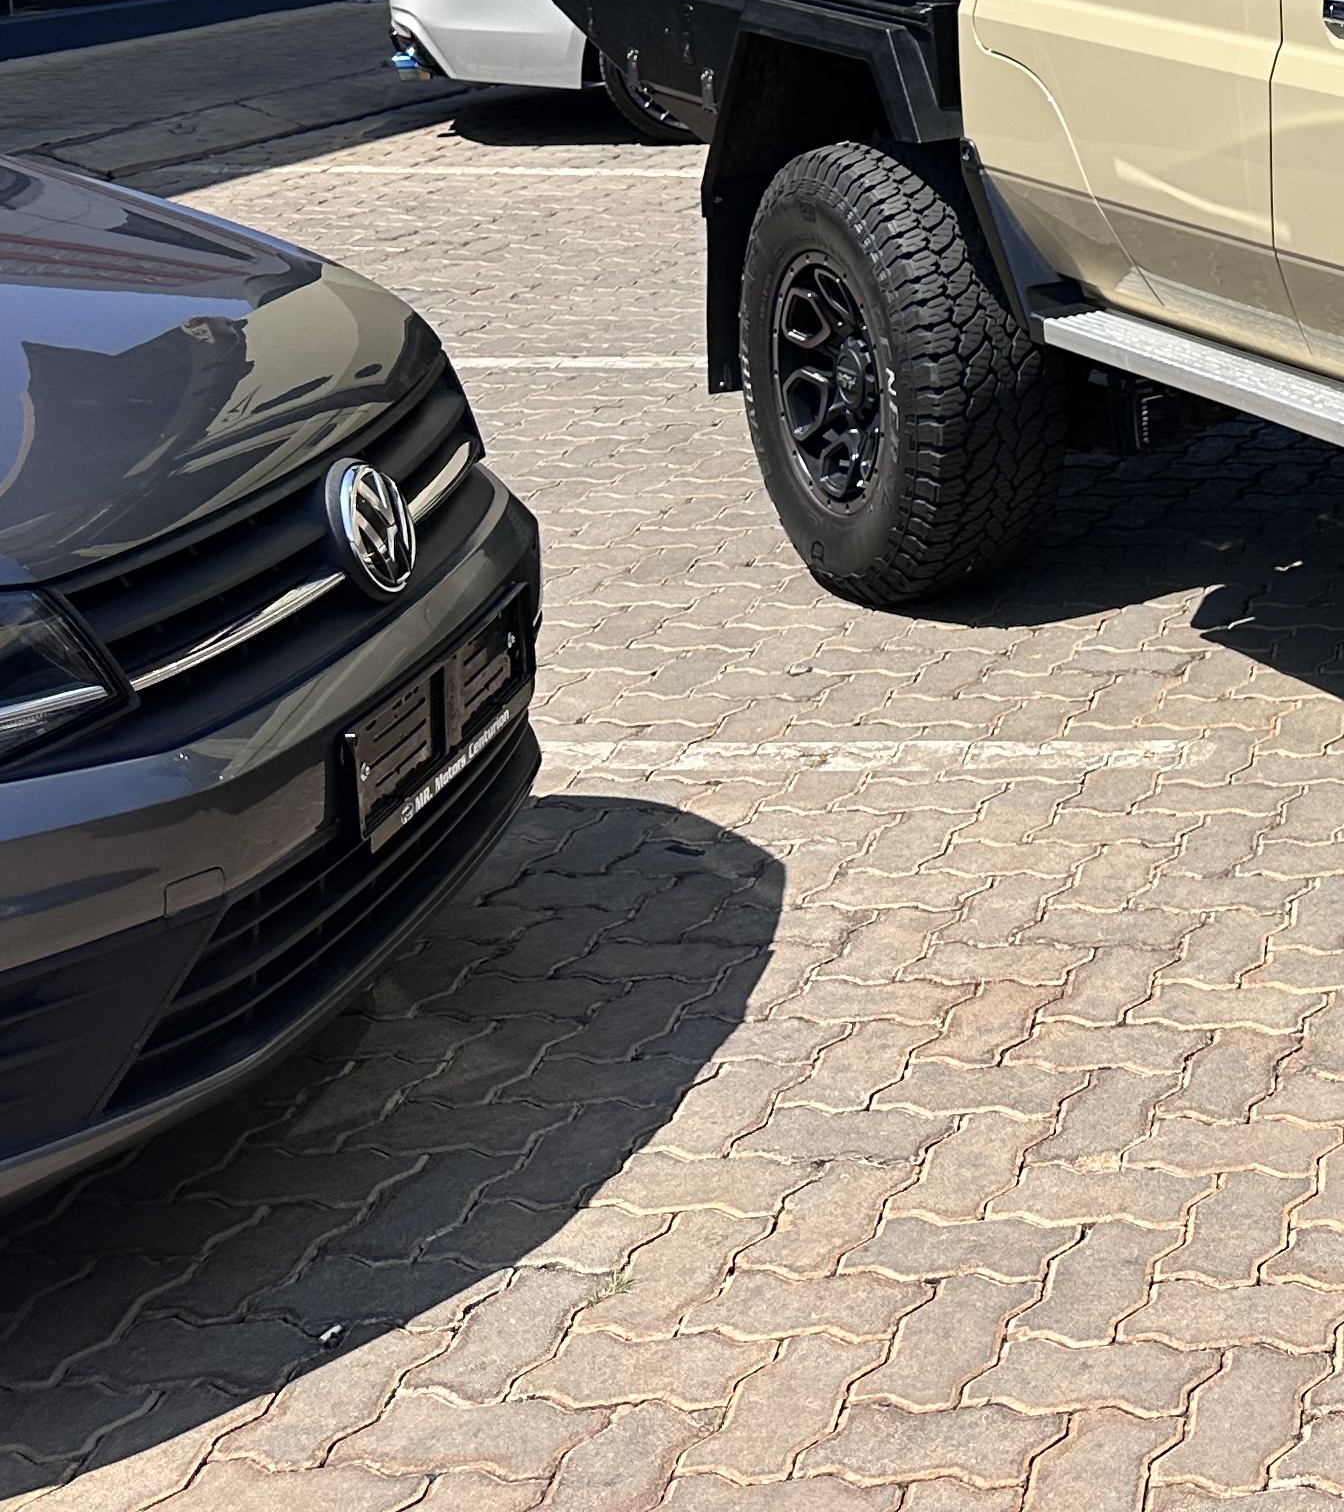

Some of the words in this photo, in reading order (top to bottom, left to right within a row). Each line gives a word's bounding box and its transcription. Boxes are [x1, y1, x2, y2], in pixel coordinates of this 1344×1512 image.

[415, 786, 435, 814] MR.
[435, 754, 467, 792] Motors
[468, 708, 510, 759] Centurion
